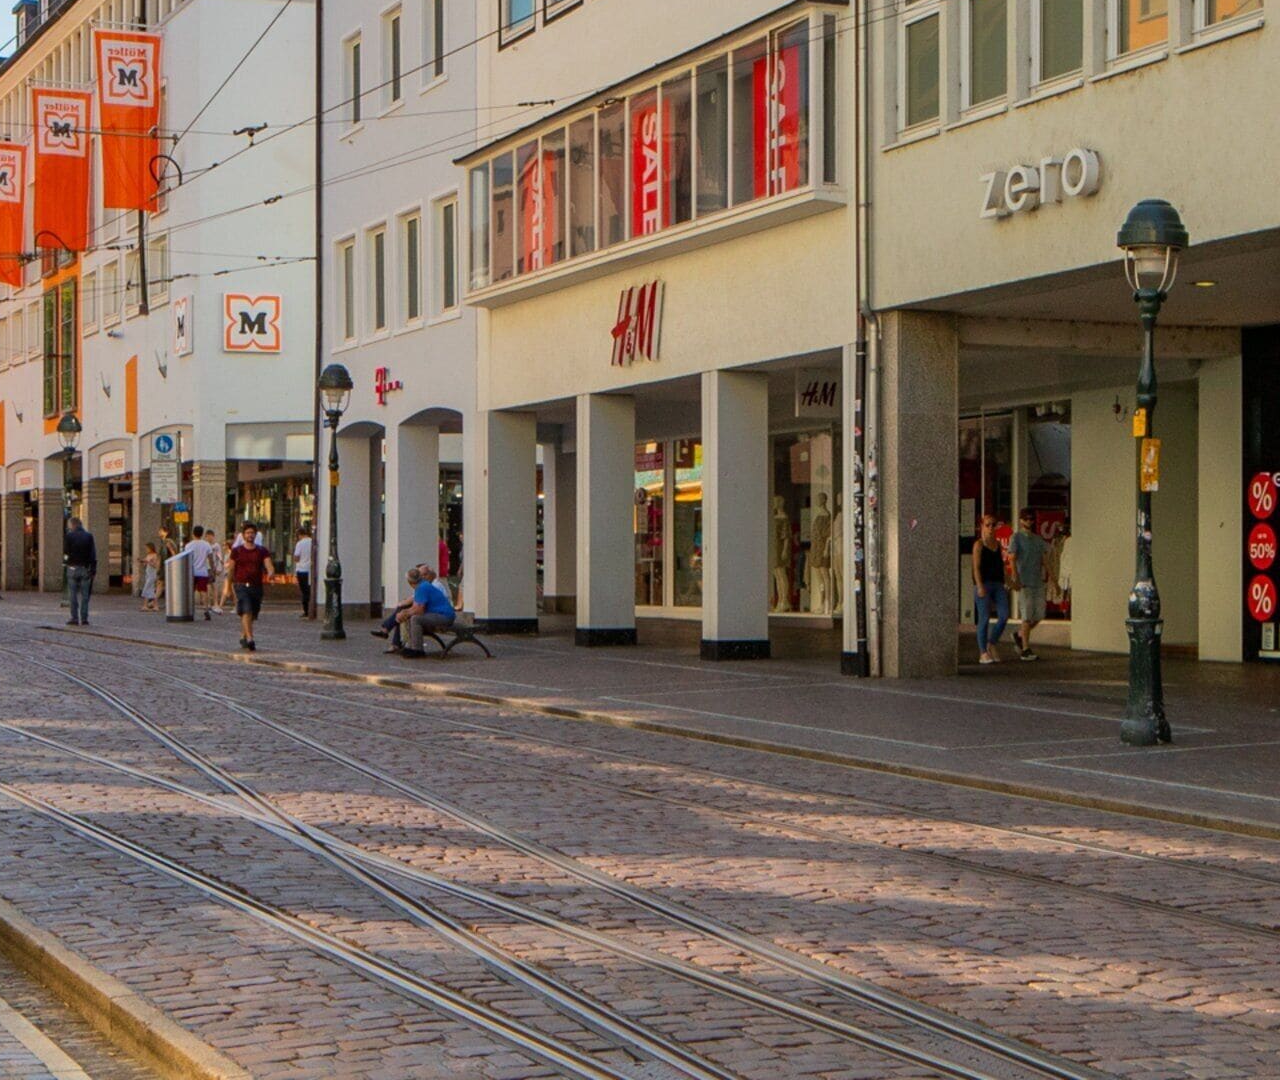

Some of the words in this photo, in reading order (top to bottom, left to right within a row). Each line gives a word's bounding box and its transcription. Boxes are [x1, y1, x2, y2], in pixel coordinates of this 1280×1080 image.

[117, 68, 138, 88] M
[51, 121, 72, 140] M
[640, 111, 659, 235] SALE
[979, 147, 1100, 219] zero
[238, 311, 267, 335] M
[610, 279, 662, 368] H&M
[801, 381, 837, 407] H&M
[1250, 543, 1276, 559] 50%
